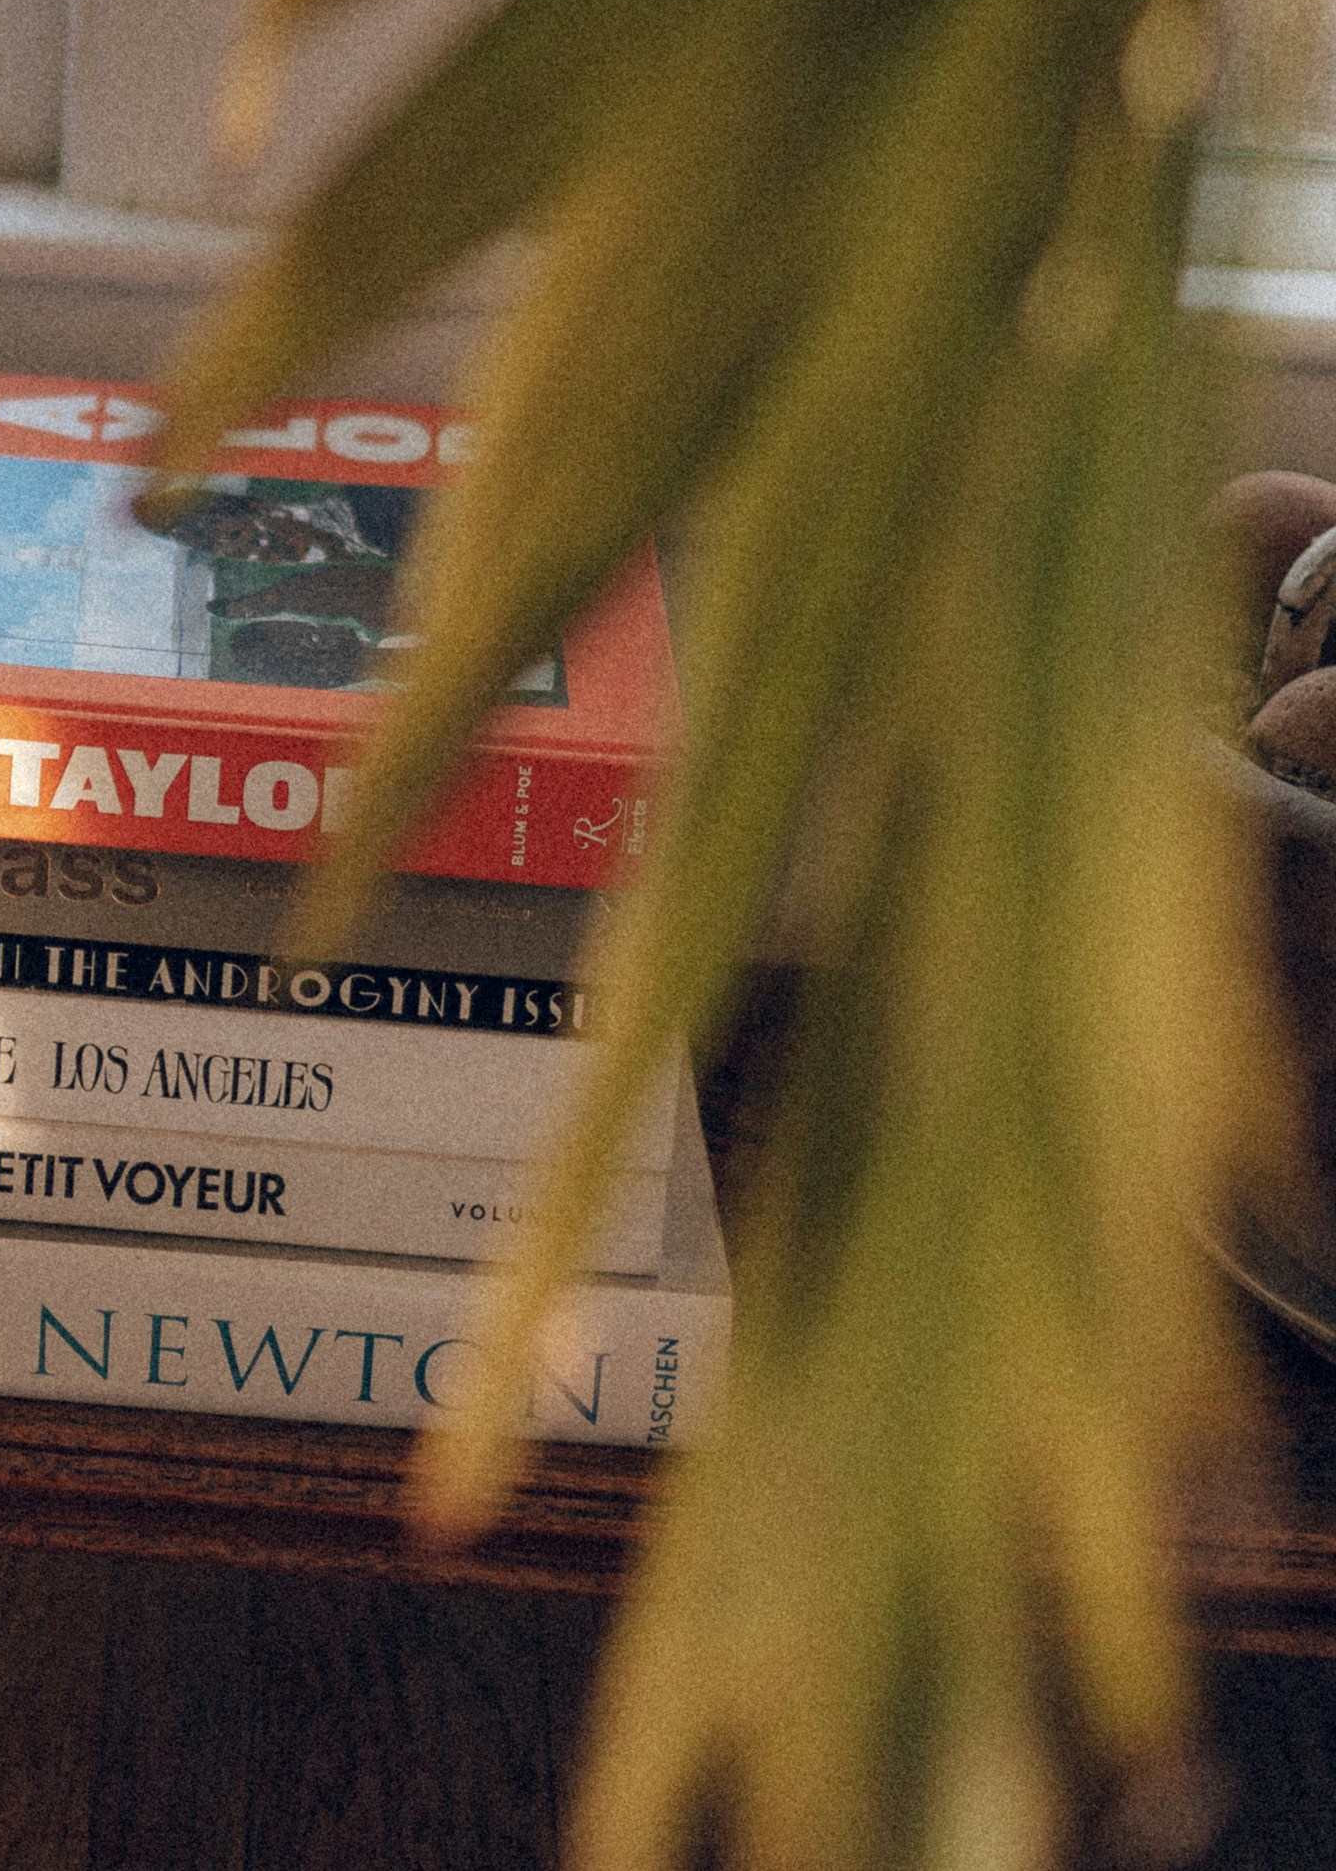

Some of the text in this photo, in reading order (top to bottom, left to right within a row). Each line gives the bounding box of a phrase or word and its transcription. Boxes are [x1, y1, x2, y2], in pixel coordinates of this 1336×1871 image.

[511, 765, 532, 866] BLUM & POE
[44, 946, 128, 991] THE
[148, 957, 480, 1023] ANDROGYNY
[501, 987, 585, 1030] ISS
[50, 1041, 130, 1094] LOS
[141, 1048, 335, 1113] ANGELES
[91, 1160, 286, 1217] VOYEUR
[451, 1202, 534, 1222] VOLU
[647, 1337, 680, 1444] TASCHEN
